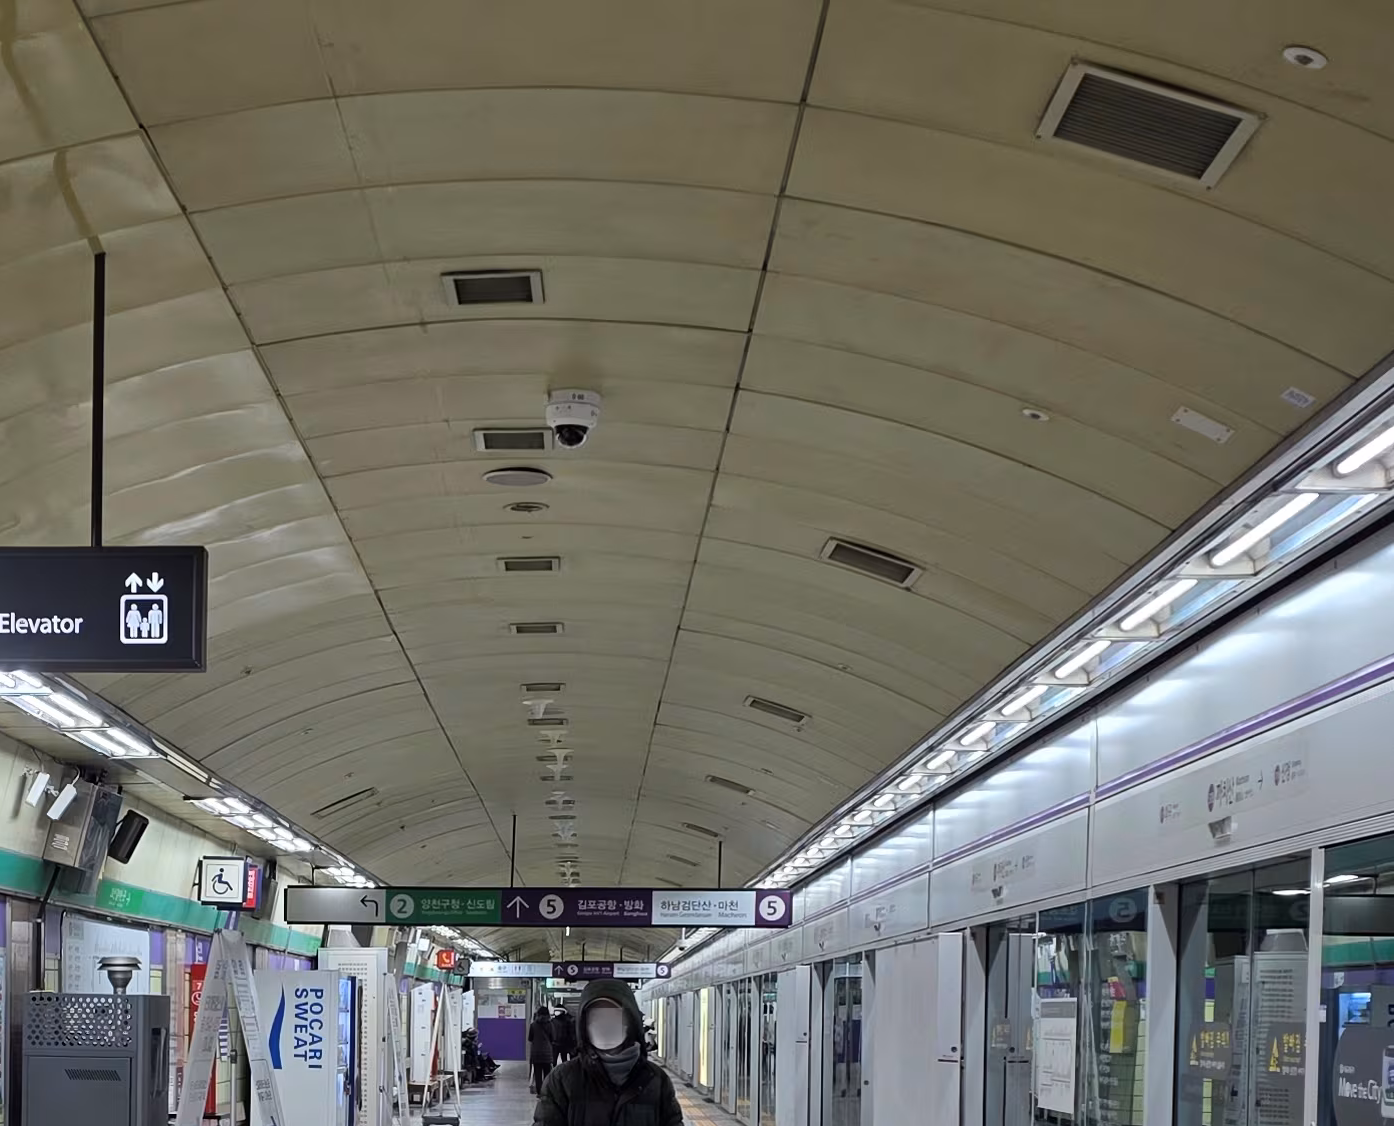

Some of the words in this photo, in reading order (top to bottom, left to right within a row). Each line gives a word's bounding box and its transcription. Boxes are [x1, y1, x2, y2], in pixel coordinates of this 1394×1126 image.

[397, 899, 407, 914] 2
[546, 899, 557, 914] 5
[766, 900, 778, 915] 5
[294, 987, 308, 1062] SWEAT
[308, 987, 323, 1069] POCARI
